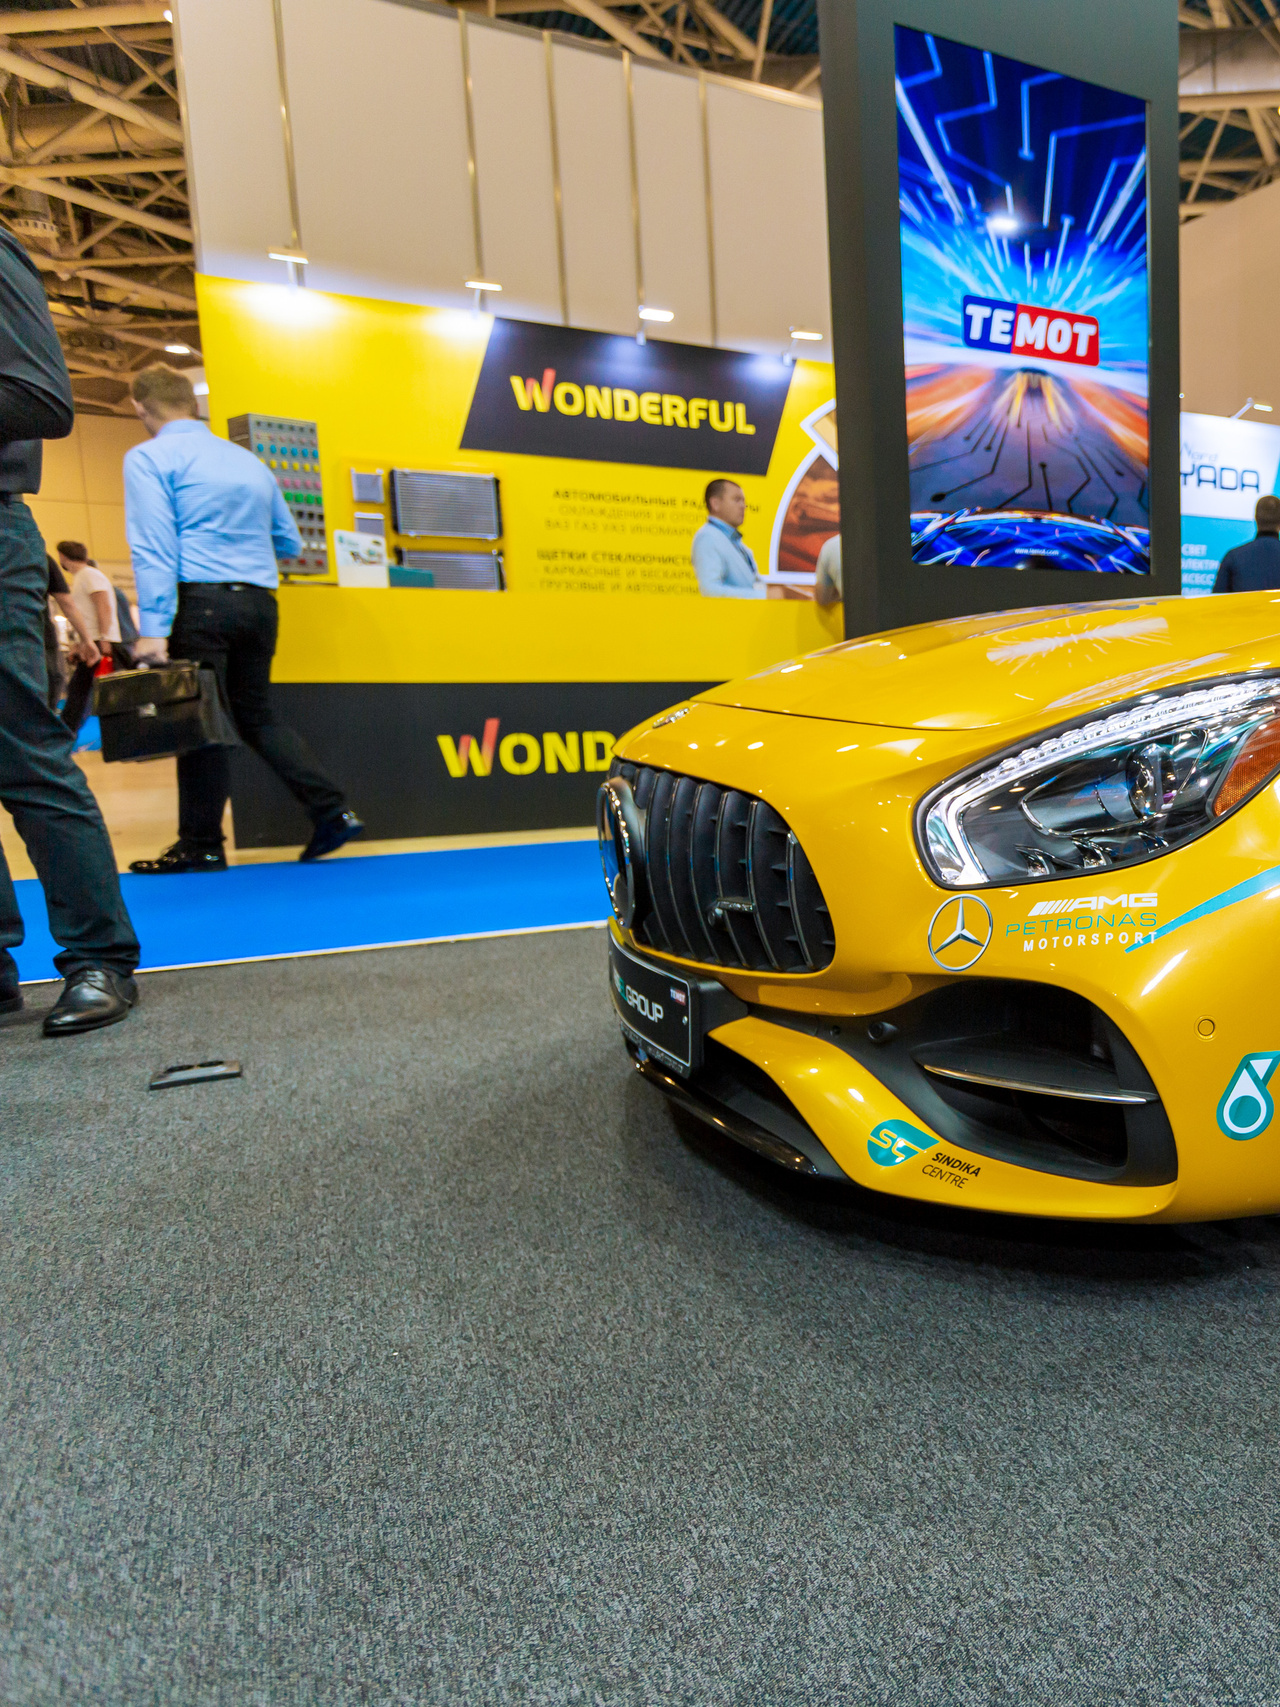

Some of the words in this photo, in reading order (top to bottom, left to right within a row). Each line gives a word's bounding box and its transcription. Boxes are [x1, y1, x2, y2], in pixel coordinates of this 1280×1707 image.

[965, 303, 1097, 357] TEMOT
[509, 367, 757, 436] WONDERFUL
[436, 717, 616, 778] WOND
[1068, 892, 1158, 911] AMG
[1005, 912, 1158, 938] PETRONAS
[1023, 931, 1158, 952] MOTORSPORT
[922, 1164, 969, 1189] CENTRE
[932, 1152, 981, 1178] SINDIKA
